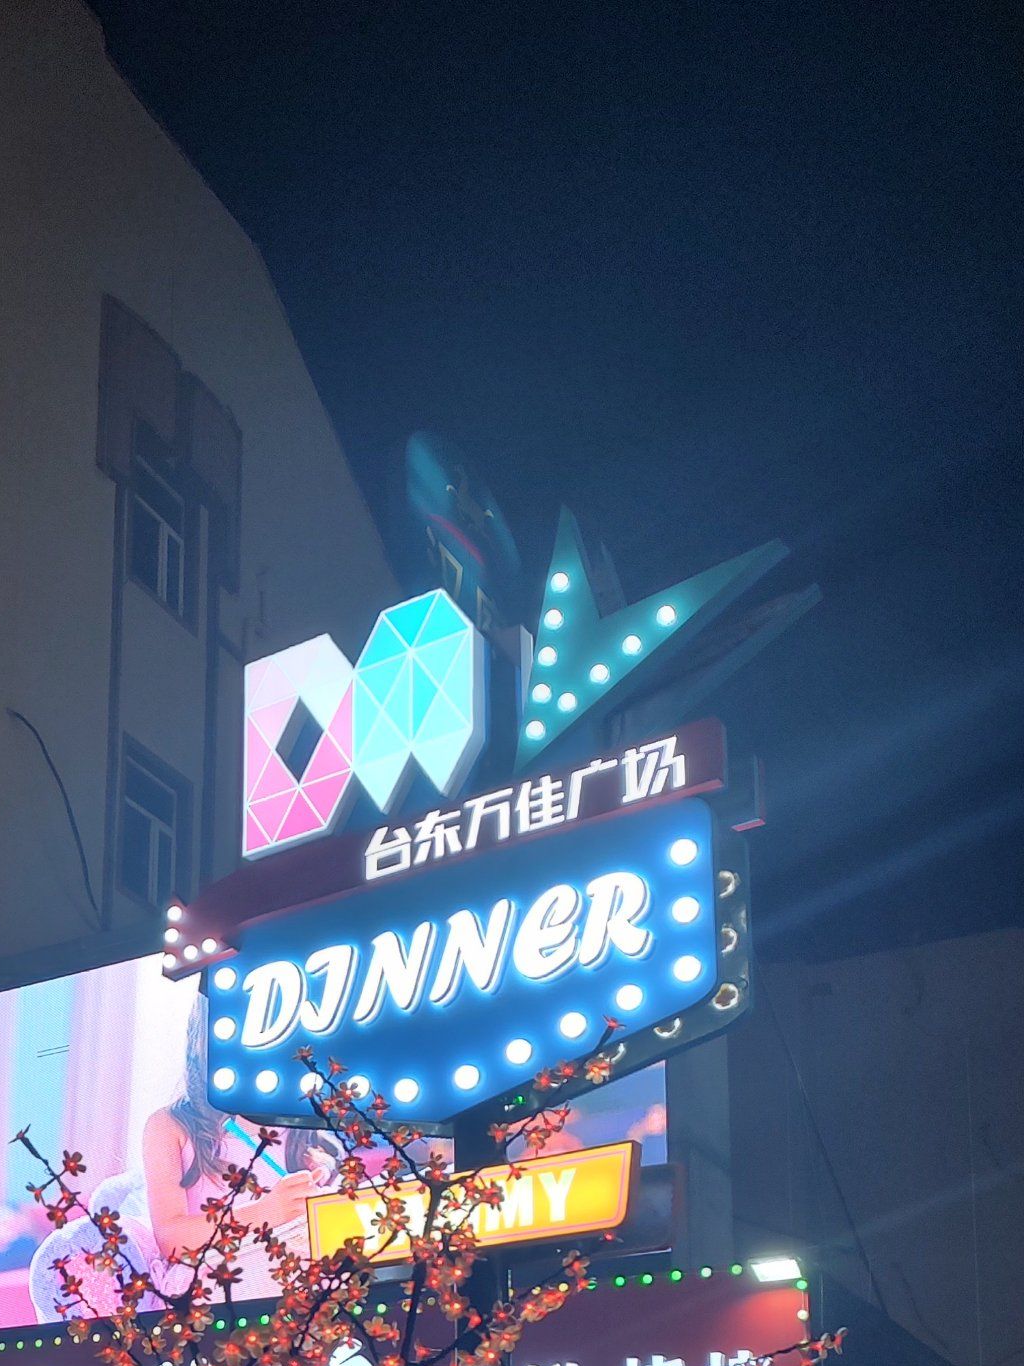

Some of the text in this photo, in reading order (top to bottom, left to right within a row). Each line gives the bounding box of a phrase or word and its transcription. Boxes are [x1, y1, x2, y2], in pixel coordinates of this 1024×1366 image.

[363, 733, 686, 880] 台东万佳广场
[240, 870, 652, 1050] DINNER
